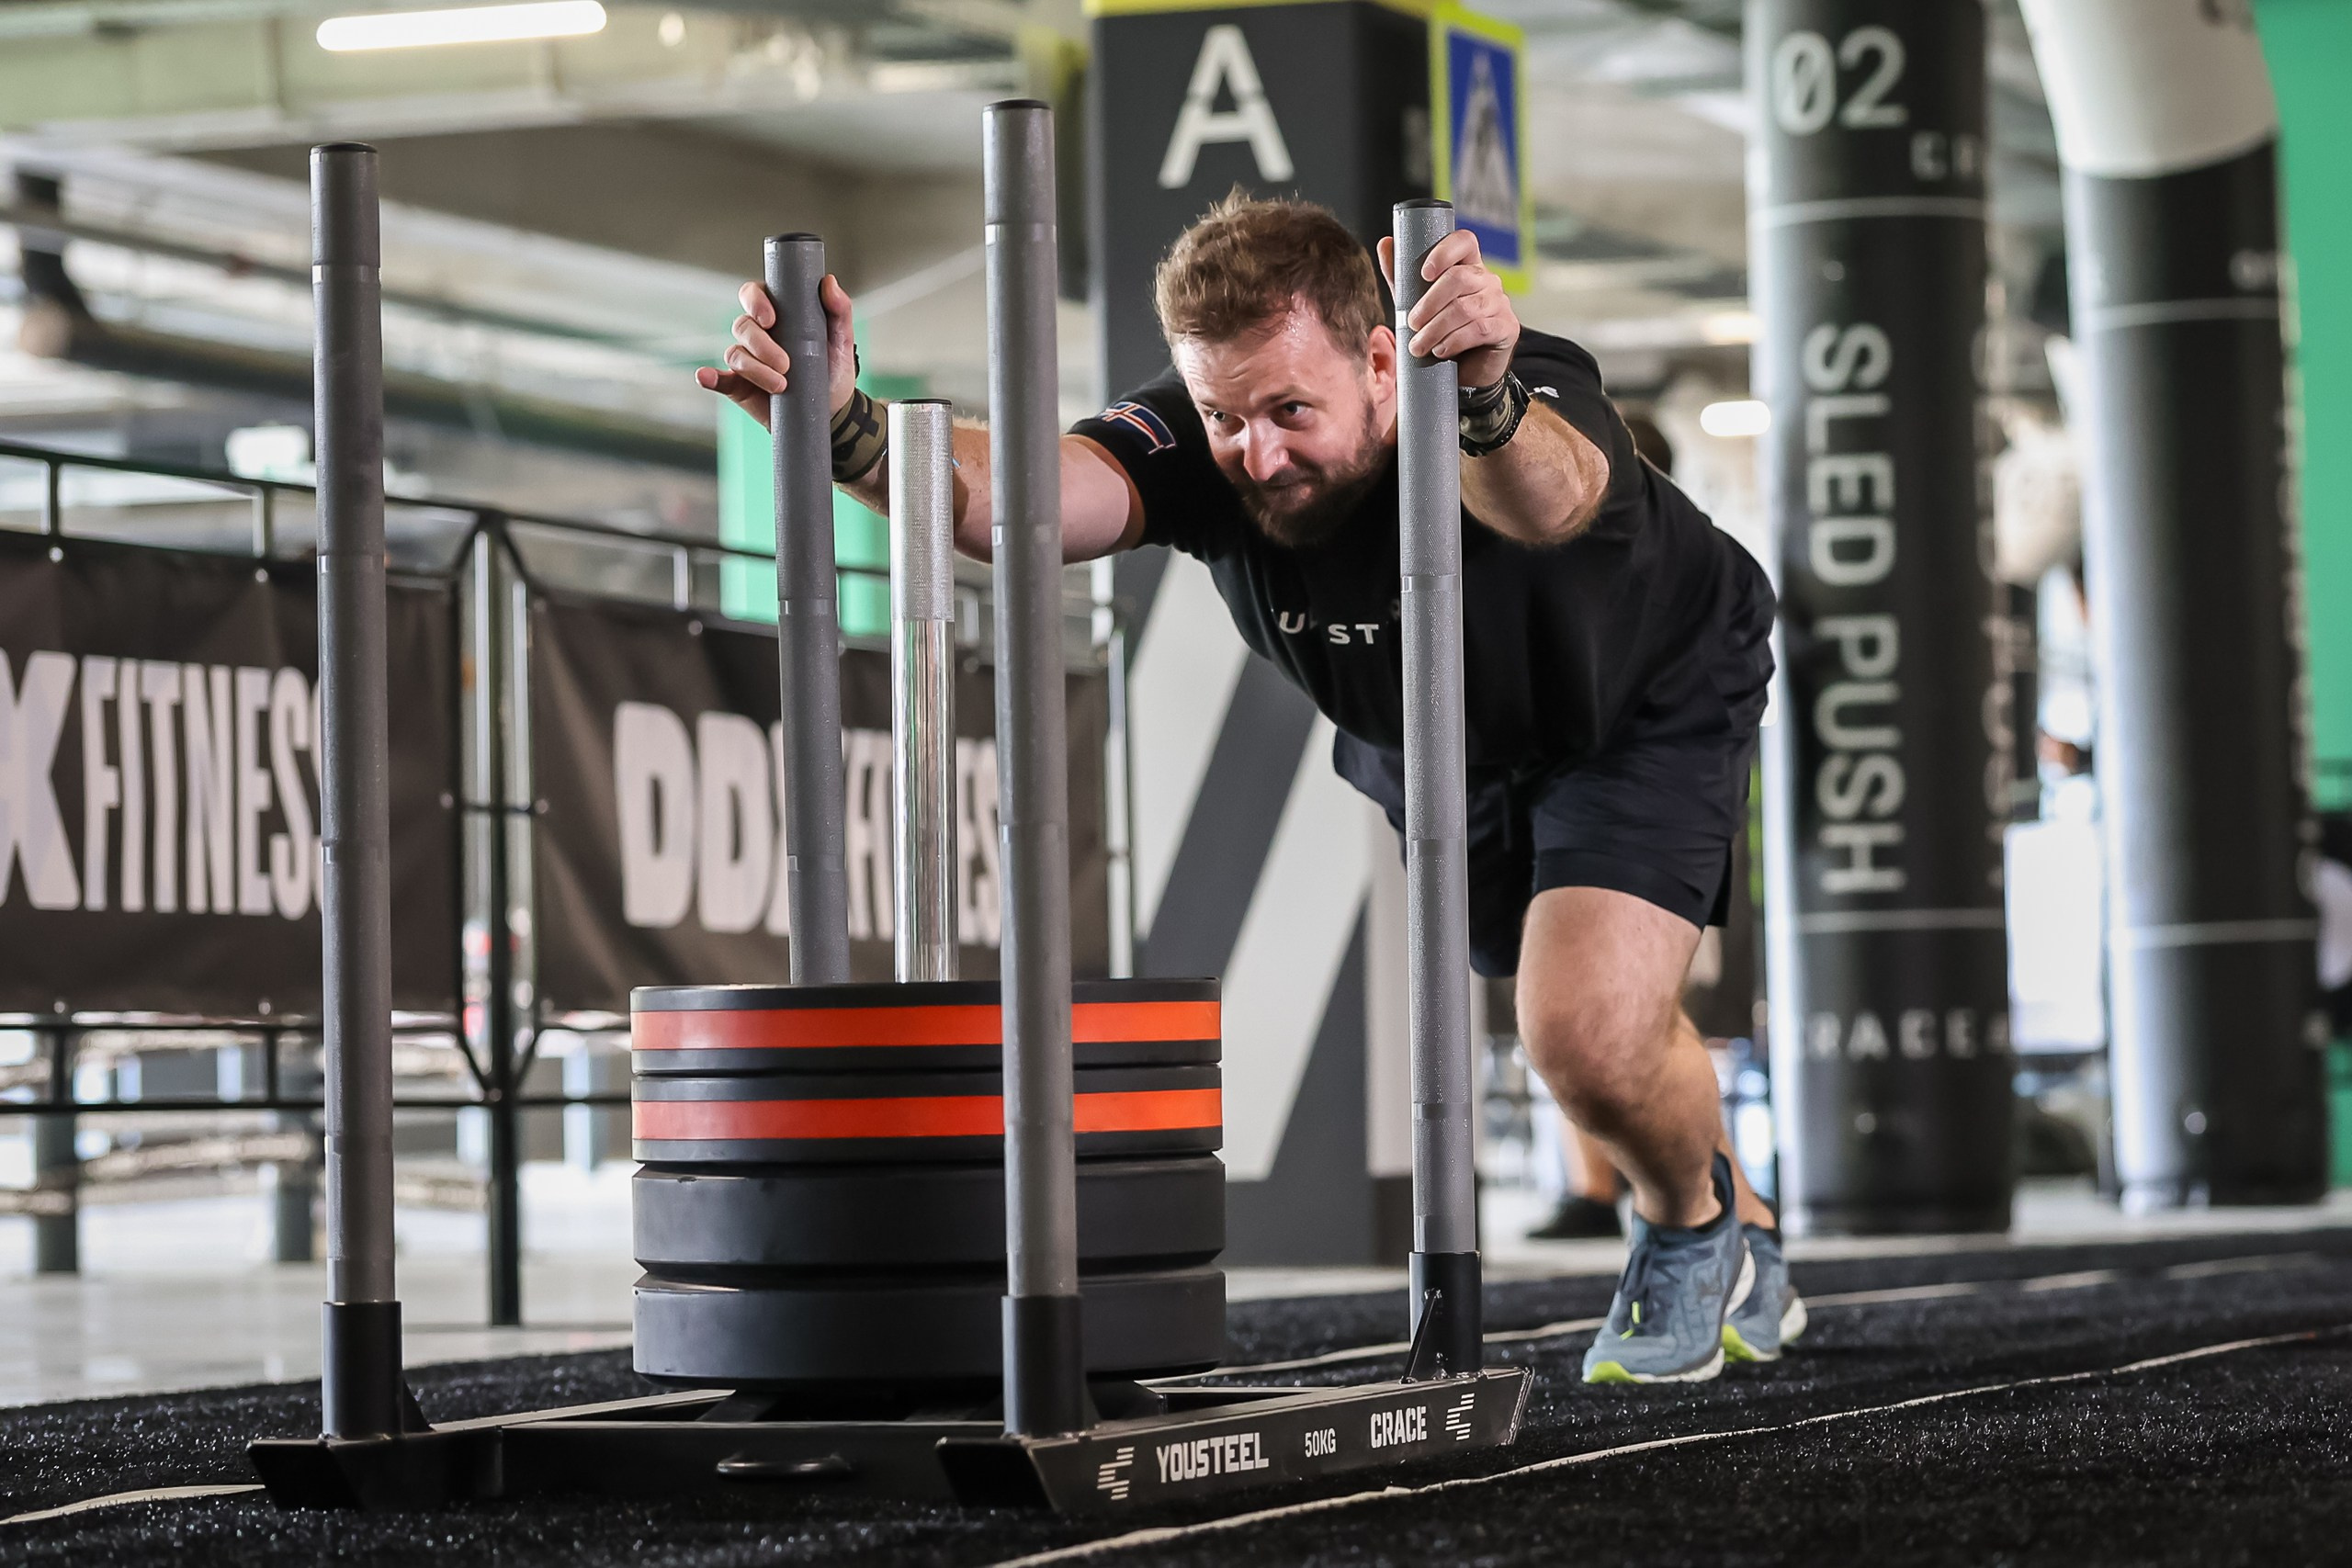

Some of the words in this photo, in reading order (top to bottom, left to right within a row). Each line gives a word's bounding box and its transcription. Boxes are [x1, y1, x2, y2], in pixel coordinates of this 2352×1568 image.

[1157, 24, 1295, 188] A
[1773, 26, 1909, 135] 02
[1802, 322, 1896, 587] SLED
[81, 654, 323, 920] FITNES
[614, 701, 790, 935] DD
[1812, 614, 1908, 897] PUSH
[1157, 1432, 1269, 1483] YOUSTEEL
[1305, 1427, 1337, 1458] 50KG
[1370, 1405, 1427, 1449] CRACE
